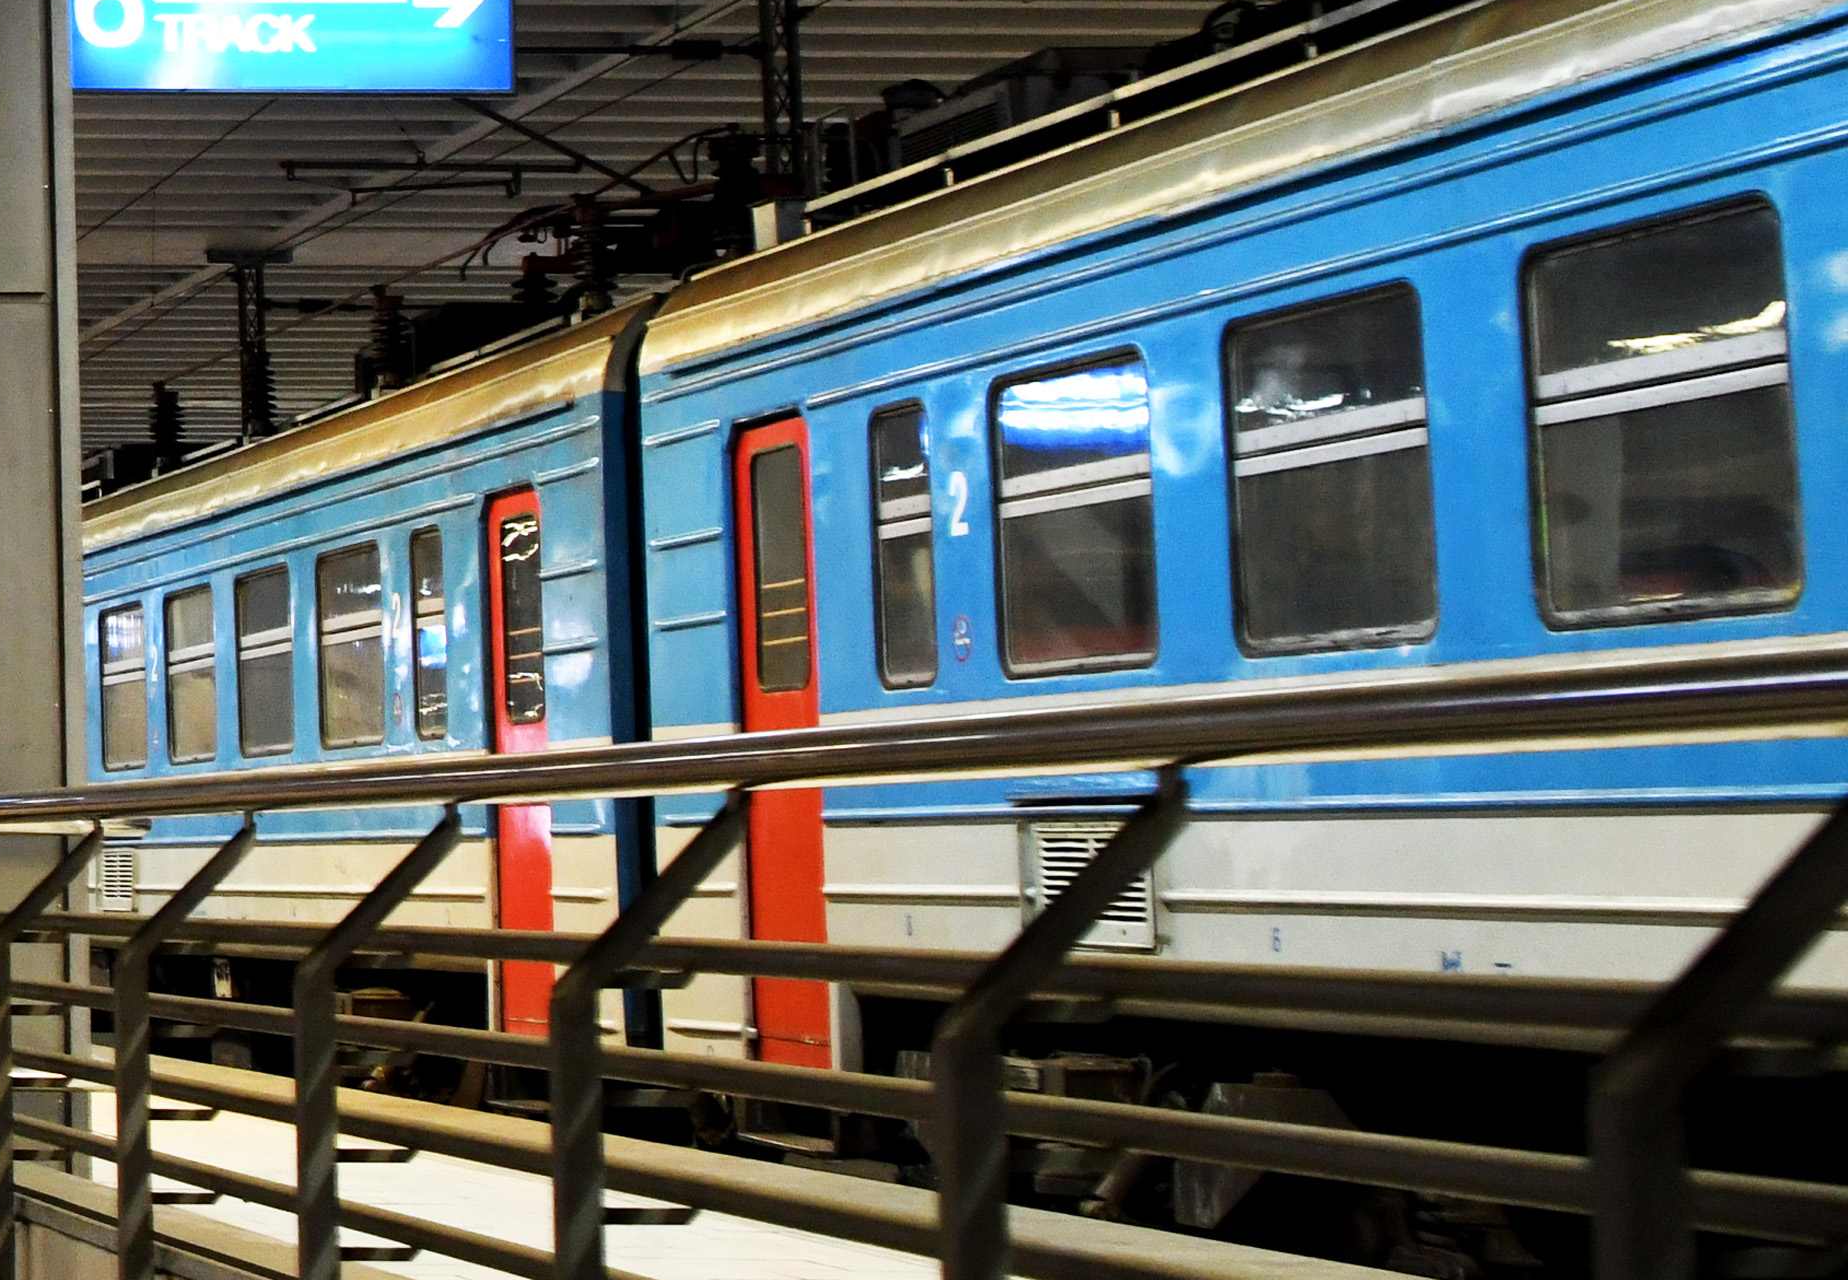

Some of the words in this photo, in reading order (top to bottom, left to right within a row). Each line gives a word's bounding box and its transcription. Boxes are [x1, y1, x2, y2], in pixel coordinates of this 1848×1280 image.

[153, 13, 317, 53] TRACK
[949, 471, 969, 536] 2
[392, 593, 401, 639] 2
[151, 645, 158, 682] 2
